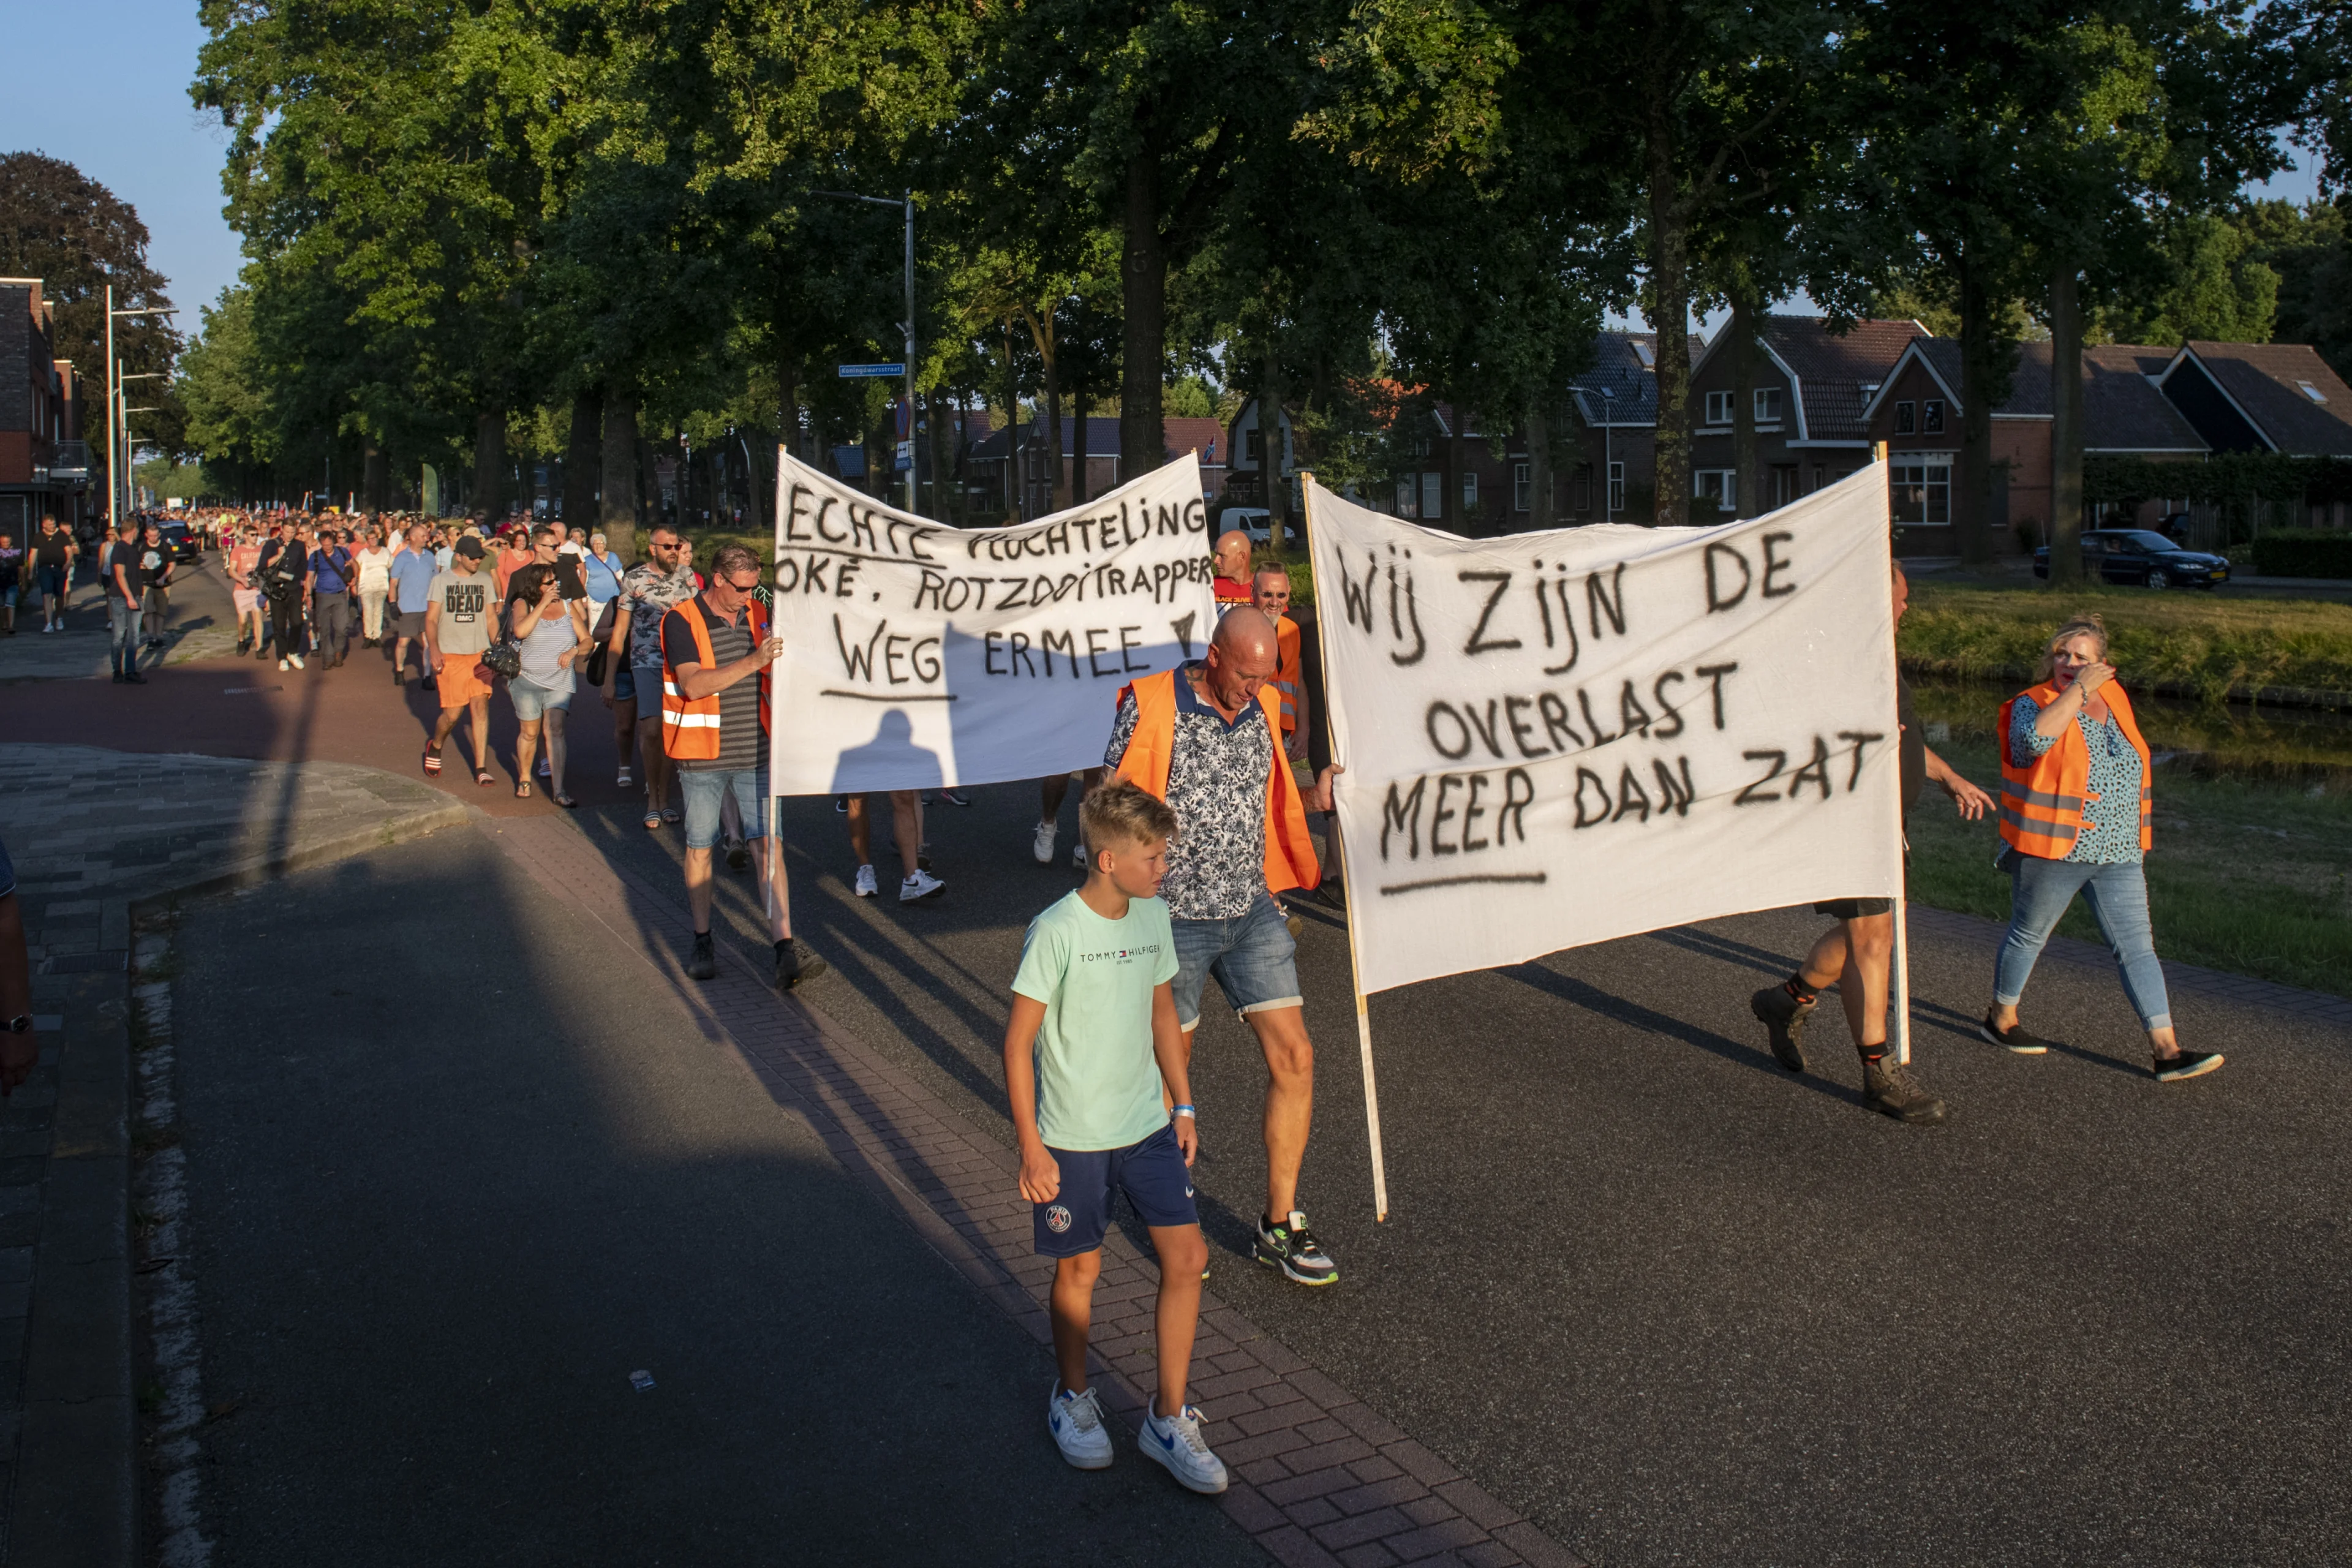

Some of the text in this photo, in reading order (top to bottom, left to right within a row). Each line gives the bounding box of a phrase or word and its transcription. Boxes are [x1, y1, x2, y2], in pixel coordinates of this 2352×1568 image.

[841, 366, 901, 375] Koningdwarsstraat
[788, 483, 941, 559] ECHTE
[446, 585, 484, 595] WALKING
[446, 595, 484, 612] DEAD
[1703, 531, 1796, 614] DE
[833, 613, 941, 685] WEG
[984, 625, 1150, 679] ERMEE
[1426, 662, 1738, 761] OVERLAST
[1380, 731, 1884, 862] MEER DAN ZAT
[1080, 951, 1116, 962] TOMMY
